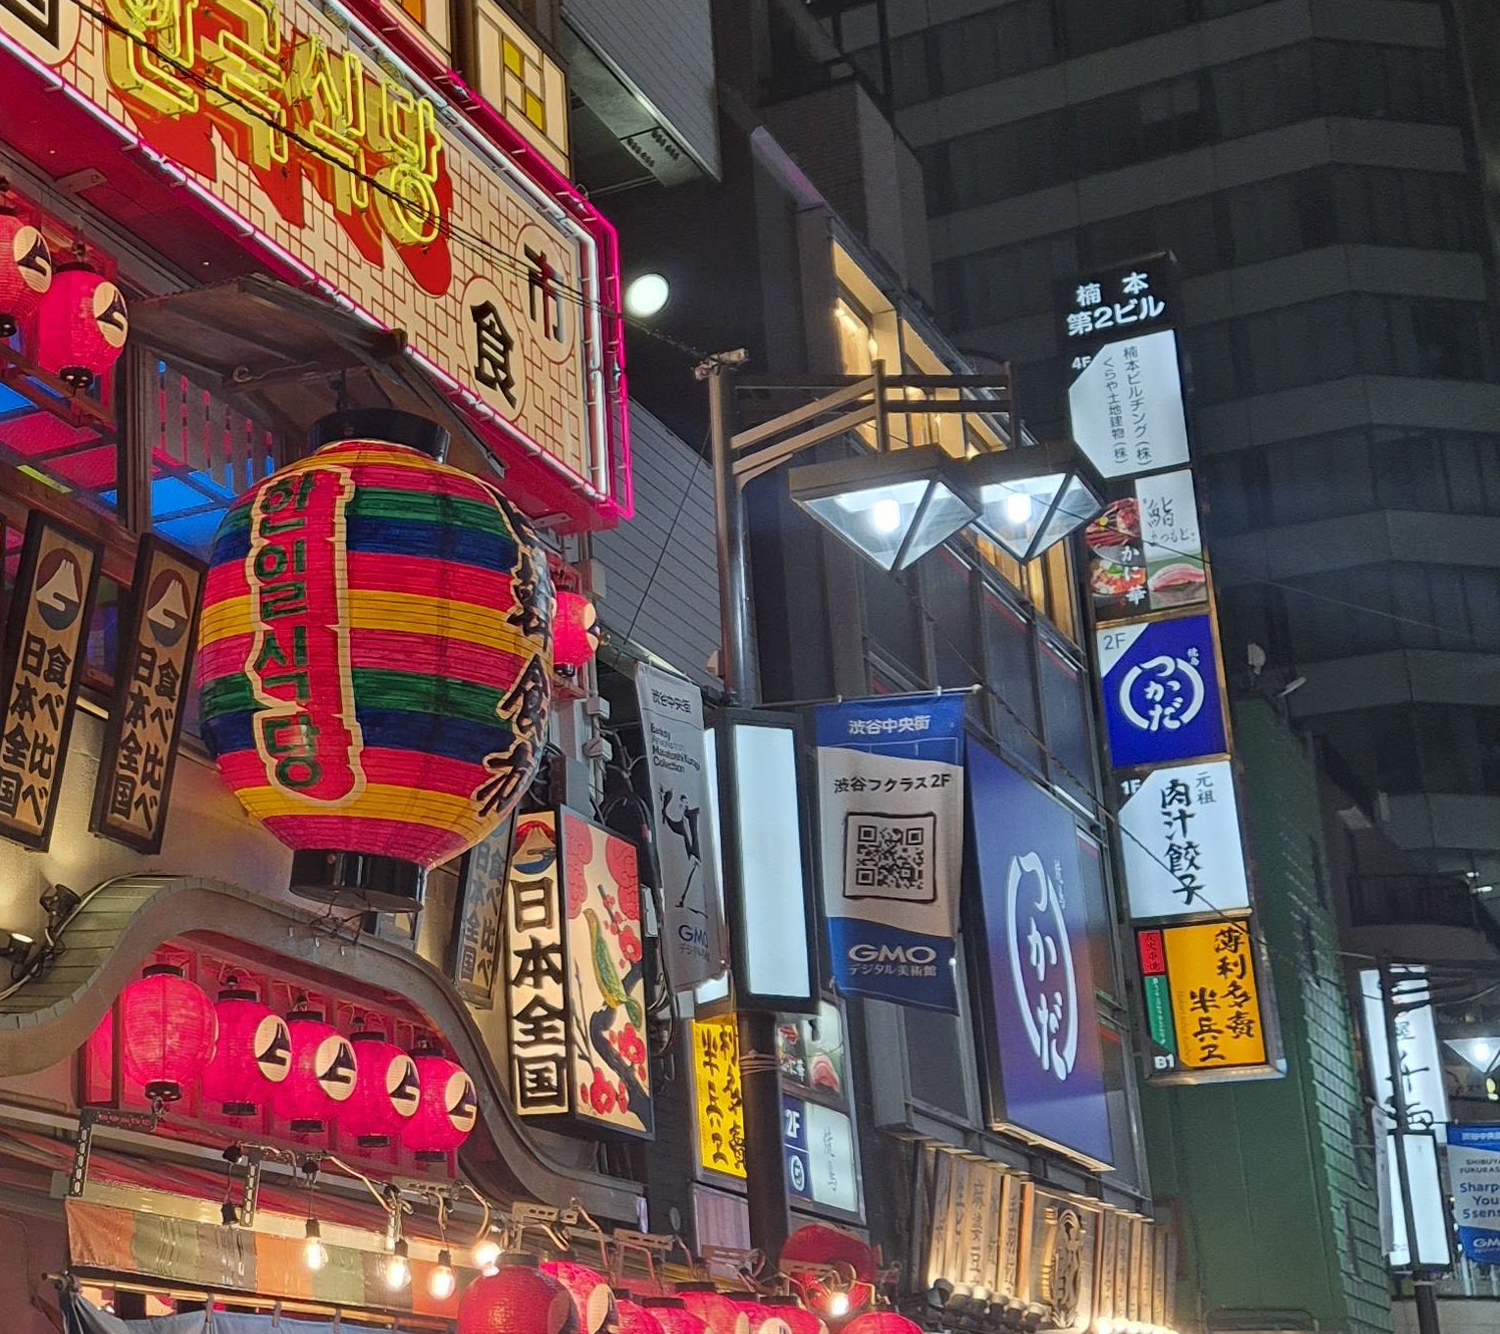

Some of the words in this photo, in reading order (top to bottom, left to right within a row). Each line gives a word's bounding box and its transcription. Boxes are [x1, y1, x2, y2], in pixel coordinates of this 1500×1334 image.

[470, 299, 516, 408] 食
[1067, 294, 1167, 338] 第2ビル
[255, 475, 323, 790] 한일식당
[1103, 630, 1127, 651] 2F
[20, 642, 72, 827] 食べ比べ
[109, 646, 158, 818] 日本全国
[847, 714, 931, 742] 渋谷中央街
[1136, 653, 1184, 733] つかだ
[133, 661, 182, 833] 食べ比べ
[1194, 770, 1217, 806] 元祖
[1160, 778, 1207, 907] 肉汁餃子
[510, 876, 568, 1110] 日本全国
[847, 943, 937, 966] GMO
[1018, 852, 1069, 1082] つかだ
[1154, 1054, 1175, 1070] B1
[784, 1109, 801, 1138] 2F
